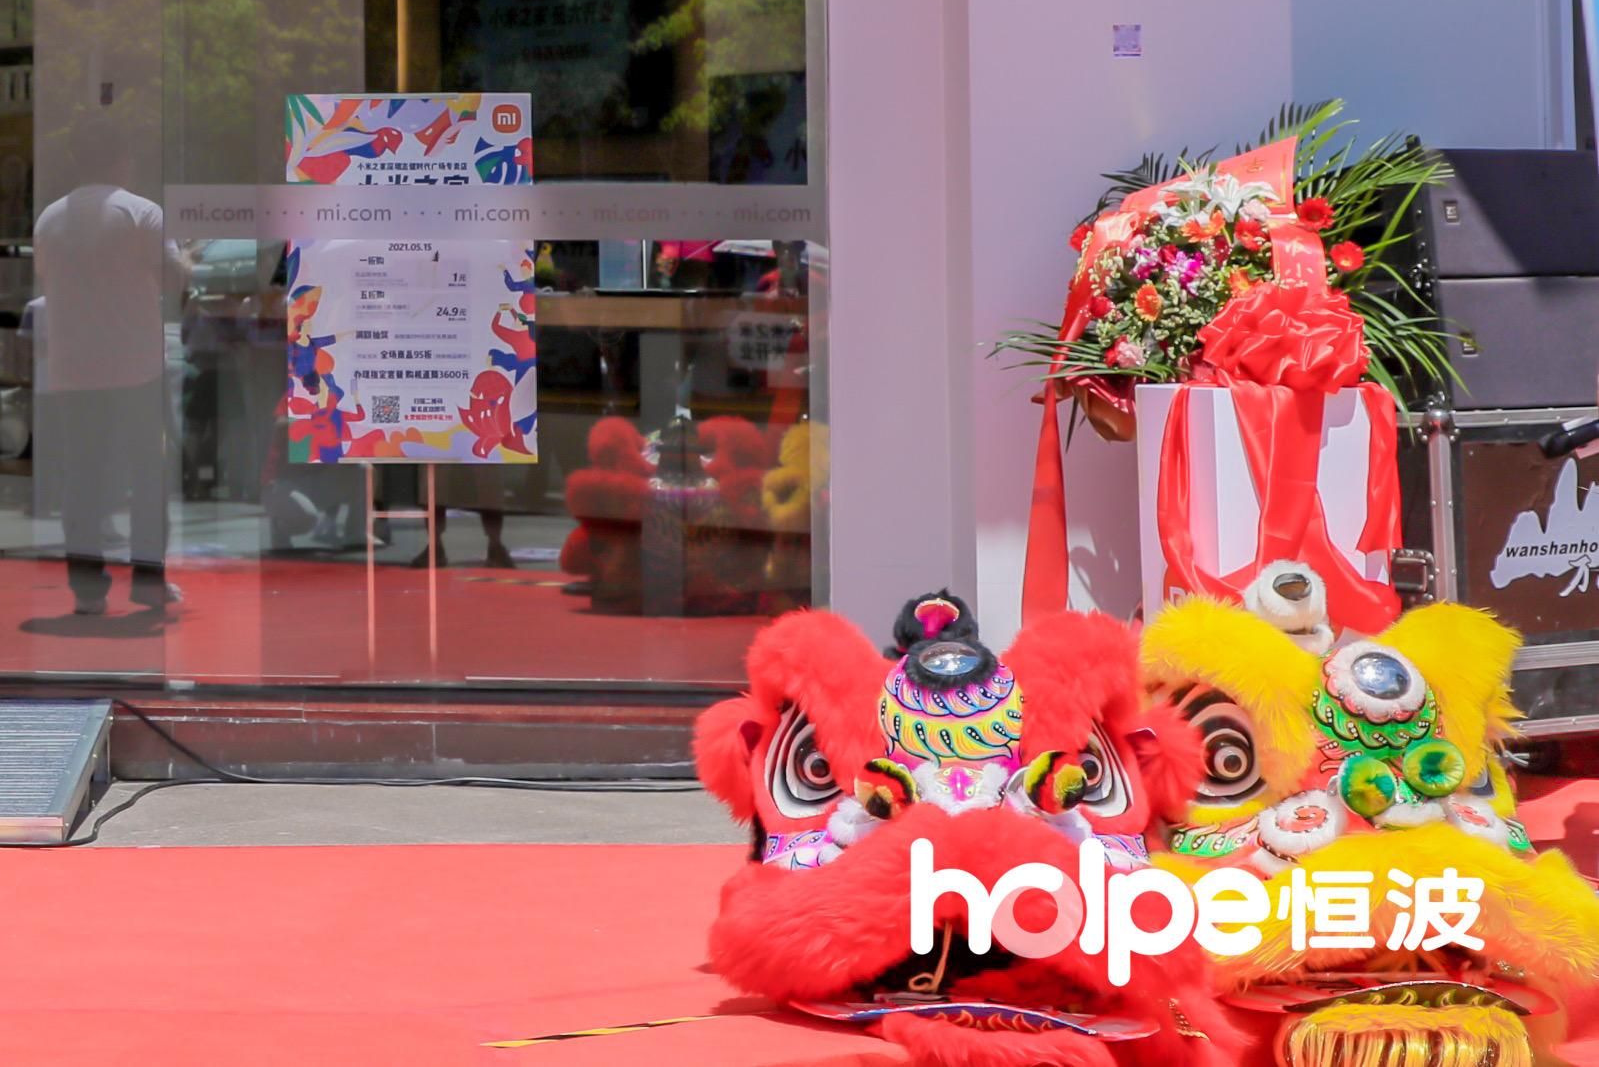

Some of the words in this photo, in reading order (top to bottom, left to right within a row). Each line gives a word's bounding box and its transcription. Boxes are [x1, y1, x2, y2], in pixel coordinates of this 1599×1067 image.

[179, 203, 255, 223] mi.com
[316, 203, 392, 223] mi.com
[454, 203, 530, 223] mi.com
[593, 203, 670, 223] mi.com
[733, 203, 811, 223] mi.com
[388, 243, 432, 251] 2021.05.15
[436, 306, 467, 317] 24.9元
